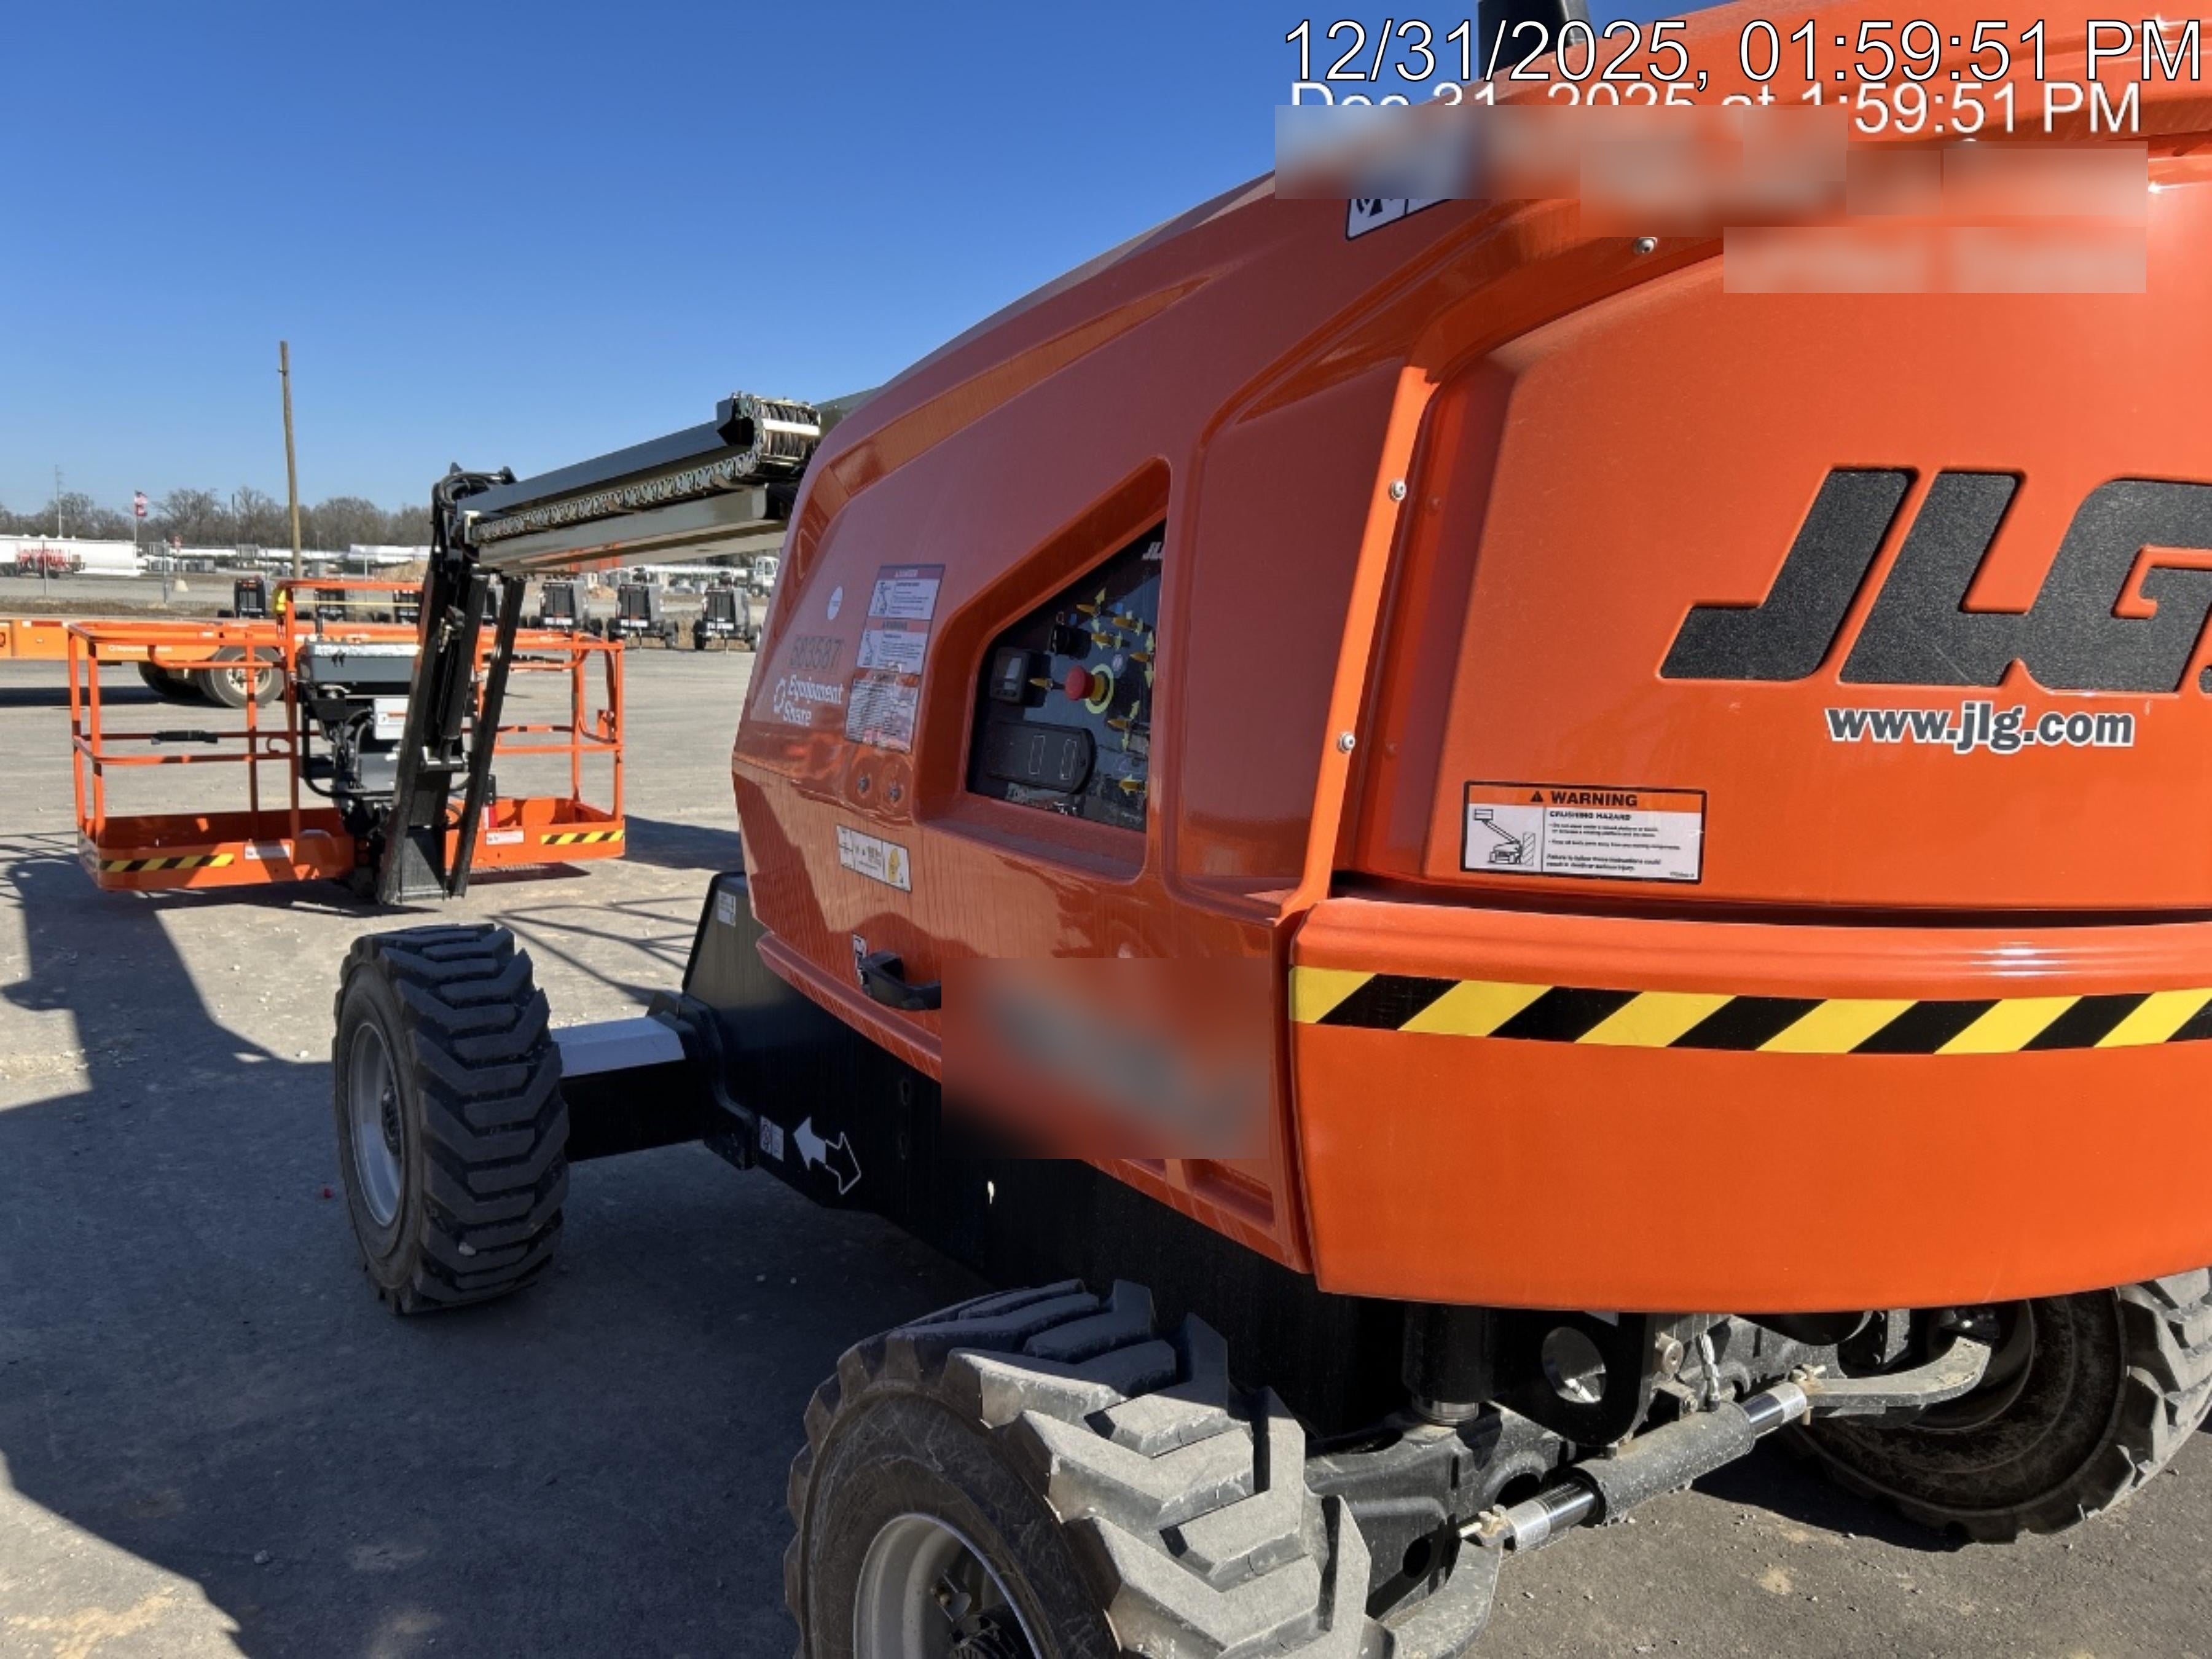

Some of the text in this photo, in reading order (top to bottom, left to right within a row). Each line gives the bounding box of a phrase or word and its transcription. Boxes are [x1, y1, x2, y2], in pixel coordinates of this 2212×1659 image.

[1141, 541, 1164, 560] JL
[1658, 467, 2212, 696] JLG
[1826, 702, 2135, 754] www.jlg.com
[1550, 790, 1638, 807] WARNING
